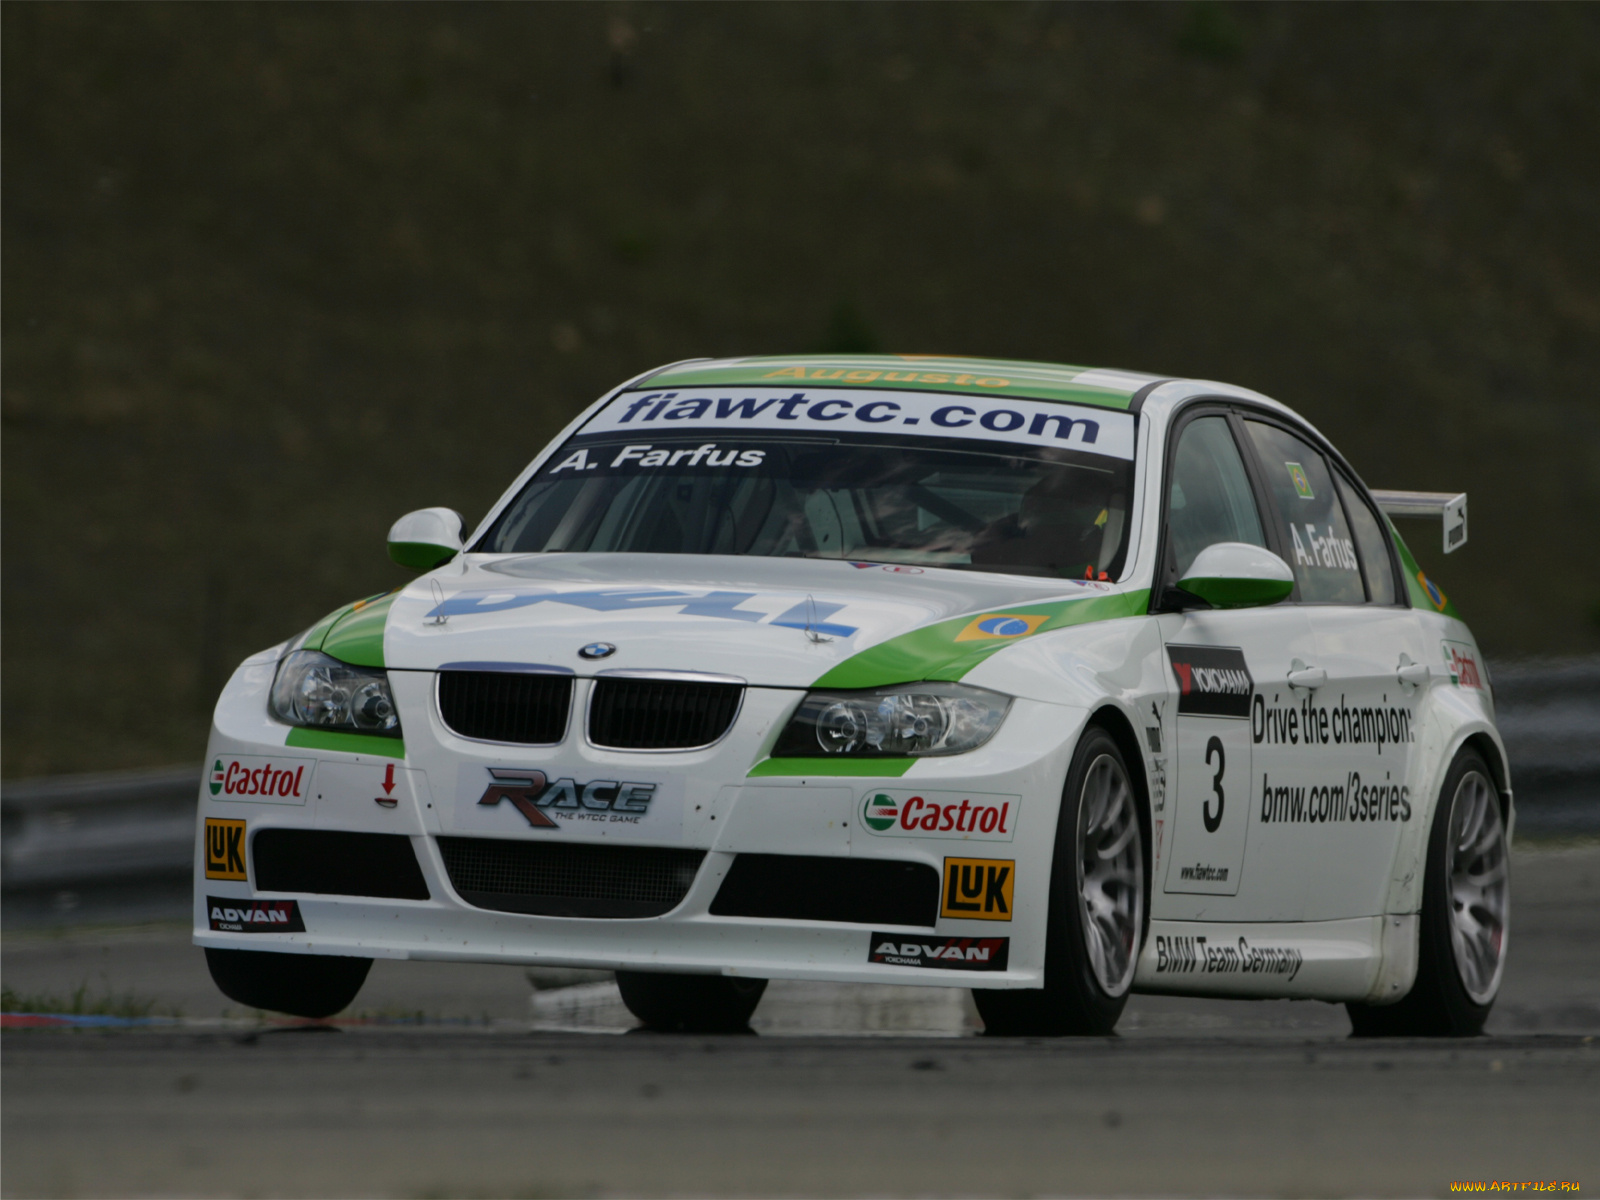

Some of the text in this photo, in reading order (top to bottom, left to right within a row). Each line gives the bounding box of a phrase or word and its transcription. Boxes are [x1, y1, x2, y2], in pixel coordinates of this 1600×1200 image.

[762, 366, 1011, 388] Augusto
[617, 391, 1101, 444] fiawtcc.com
[549, 443, 767, 474] A. Farfus
[1190, 667, 1250, 696] YOKOHAMA
[1252, 693, 1299, 745] Drive
[1301, 693, 1330, 745] the
[224, 761, 305, 797] Castrol
[1203, 735, 1226, 834] 3
[477, 767, 657, 829] RACE
[900, 796, 1010, 834] Castrol
[1260, 771, 1412, 824] bmw.com/3series
[554, 811, 641, 825] THE WTCC GAME
[210, 906, 289, 923] ADVAN
[874, 942, 990, 961] ADVAN
[884, 956, 922, 966] YOKOHAMA
[1156, 935, 1303, 982] BMW Team Germany
